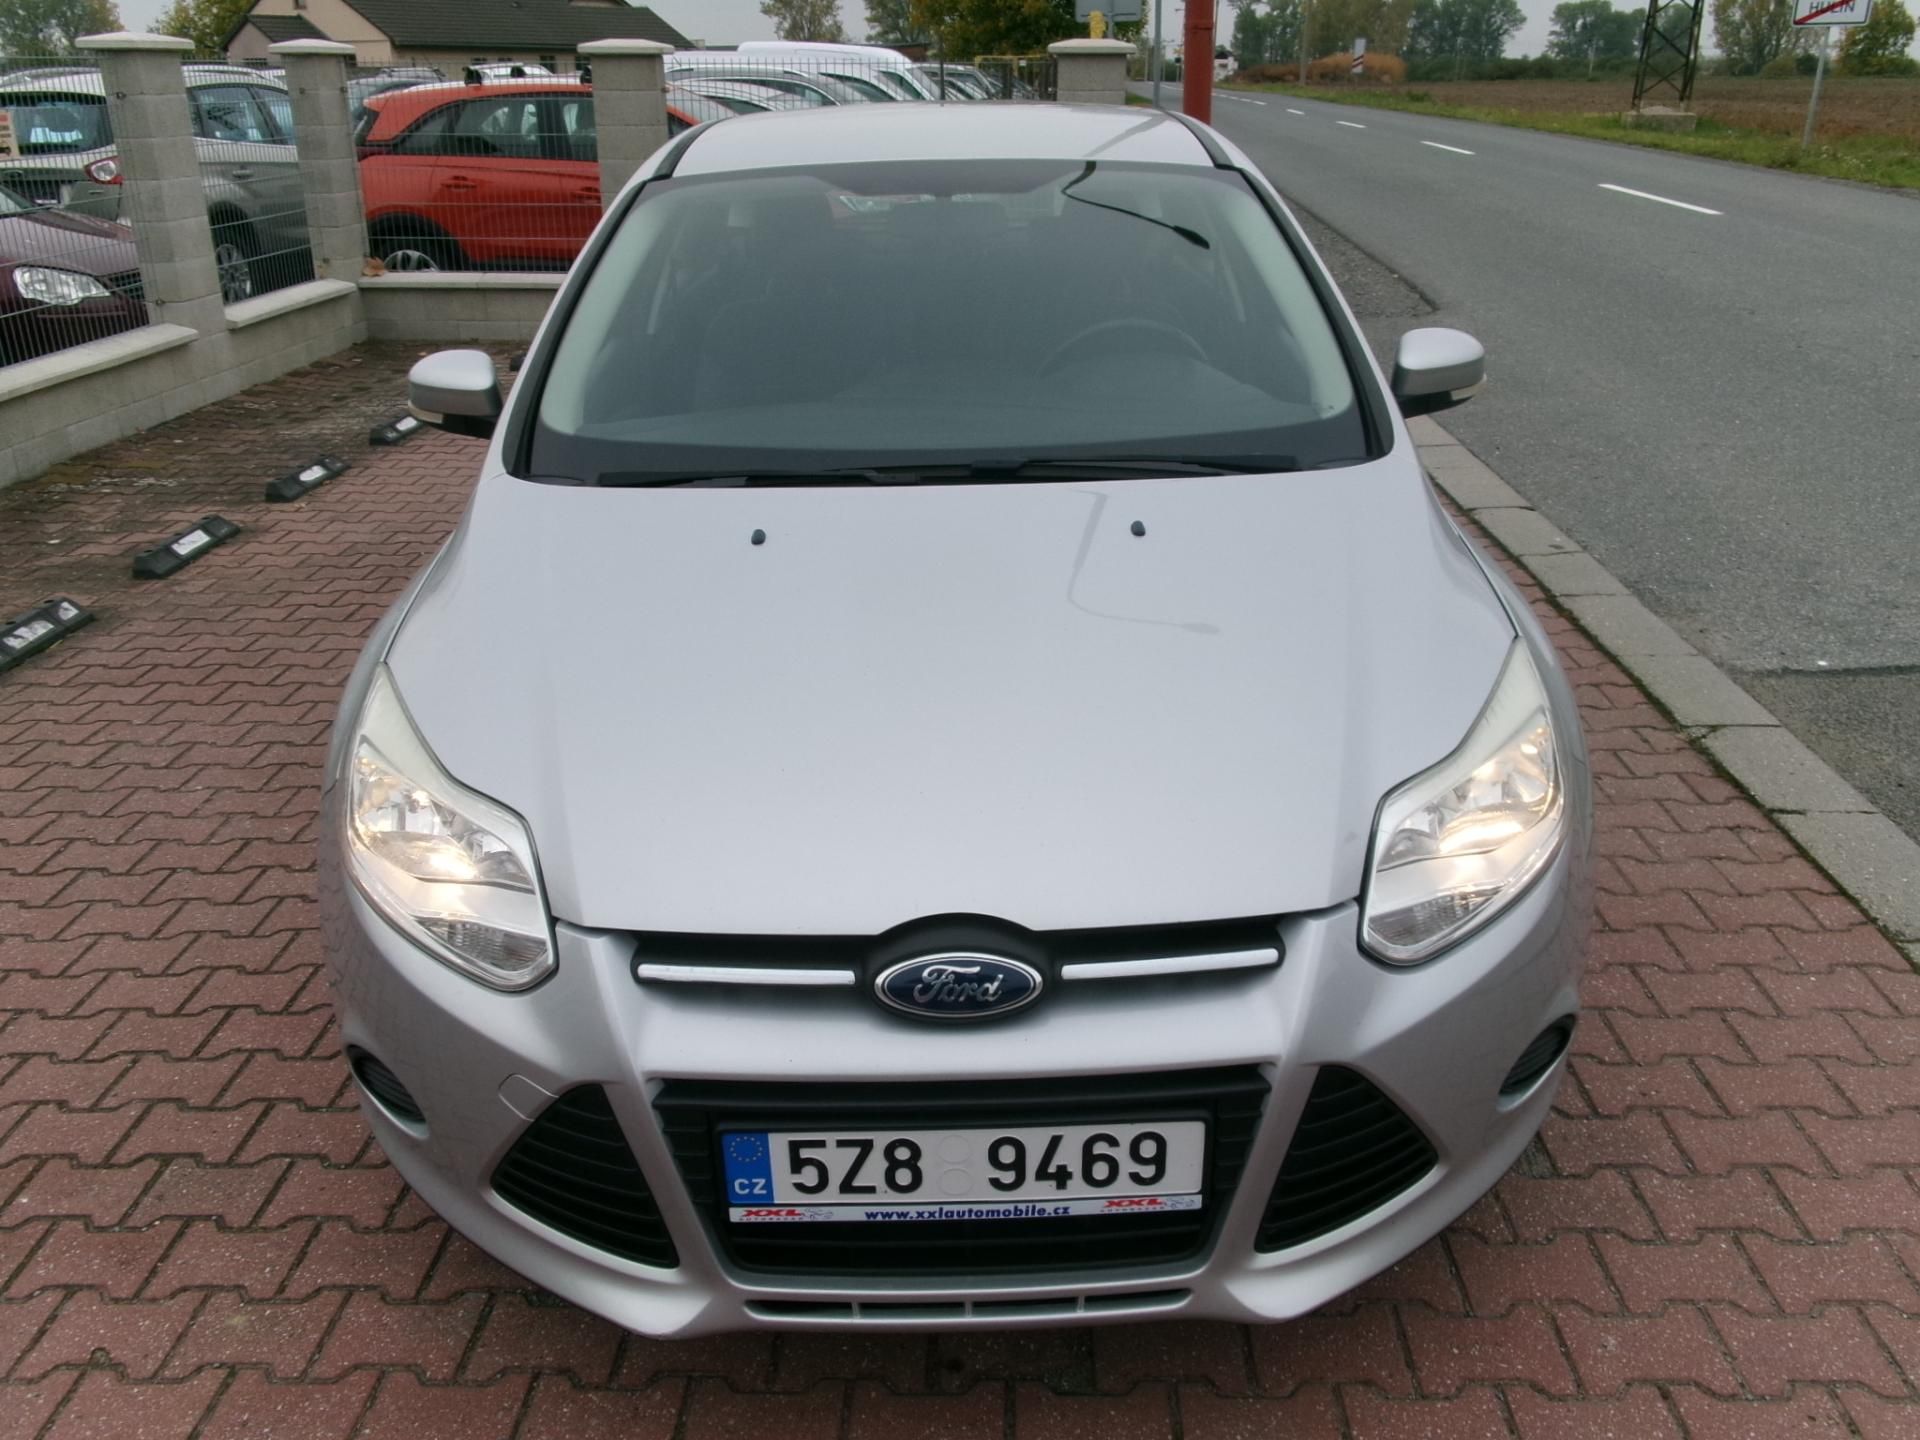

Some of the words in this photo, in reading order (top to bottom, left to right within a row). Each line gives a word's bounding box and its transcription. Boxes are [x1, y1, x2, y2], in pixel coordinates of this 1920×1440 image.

[913, 965, 1003, 1003] Ford
[788, 1138, 923, 1195] 5Z8
[988, 1131, 1167, 1192] 9469
[734, 1178, 767, 1195] CZ
[864, 1205, 1071, 1221] www.xxlautomobile.cz
